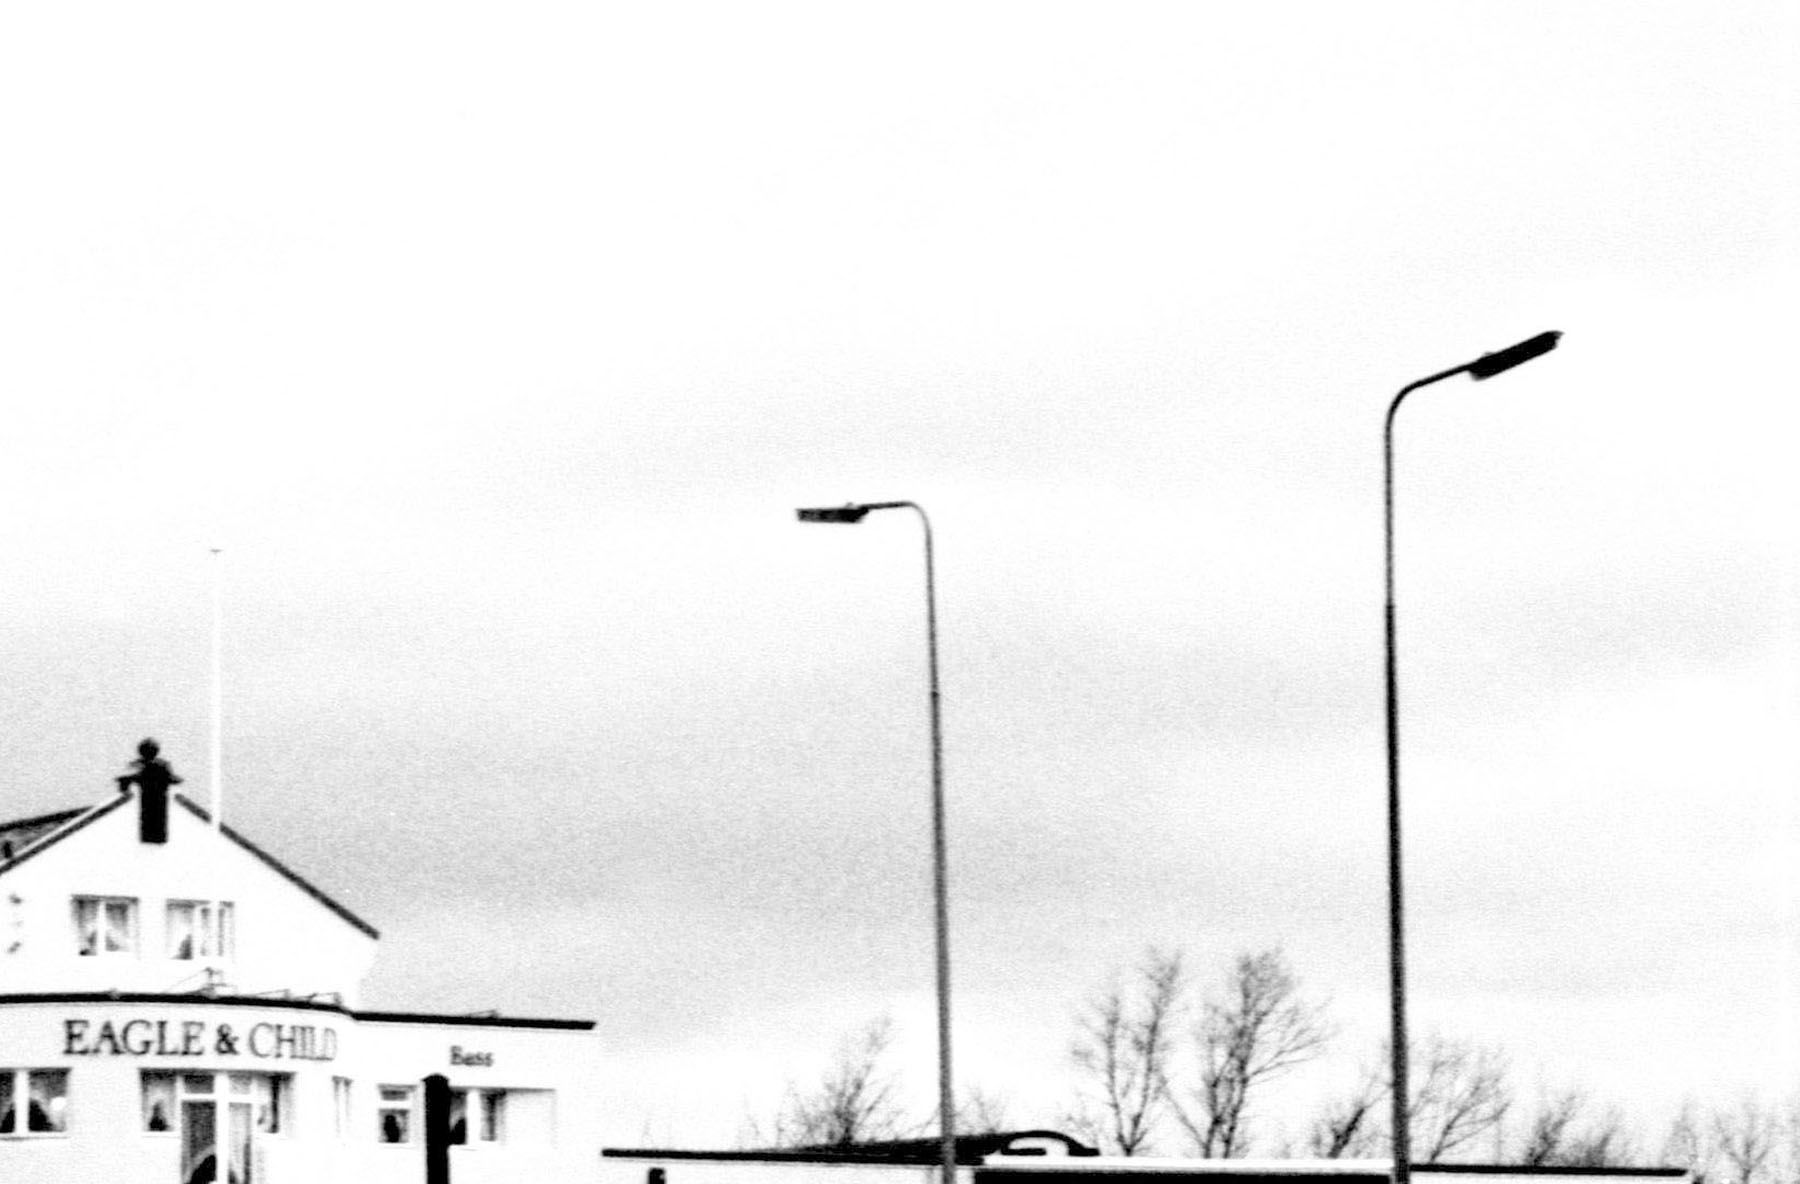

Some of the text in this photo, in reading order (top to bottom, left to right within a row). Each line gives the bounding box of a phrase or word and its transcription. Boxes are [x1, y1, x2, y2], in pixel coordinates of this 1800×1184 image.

[62, 1019, 338, 1061] EAGLE & CHILD
[449, 1045, 495, 1068] Bass
